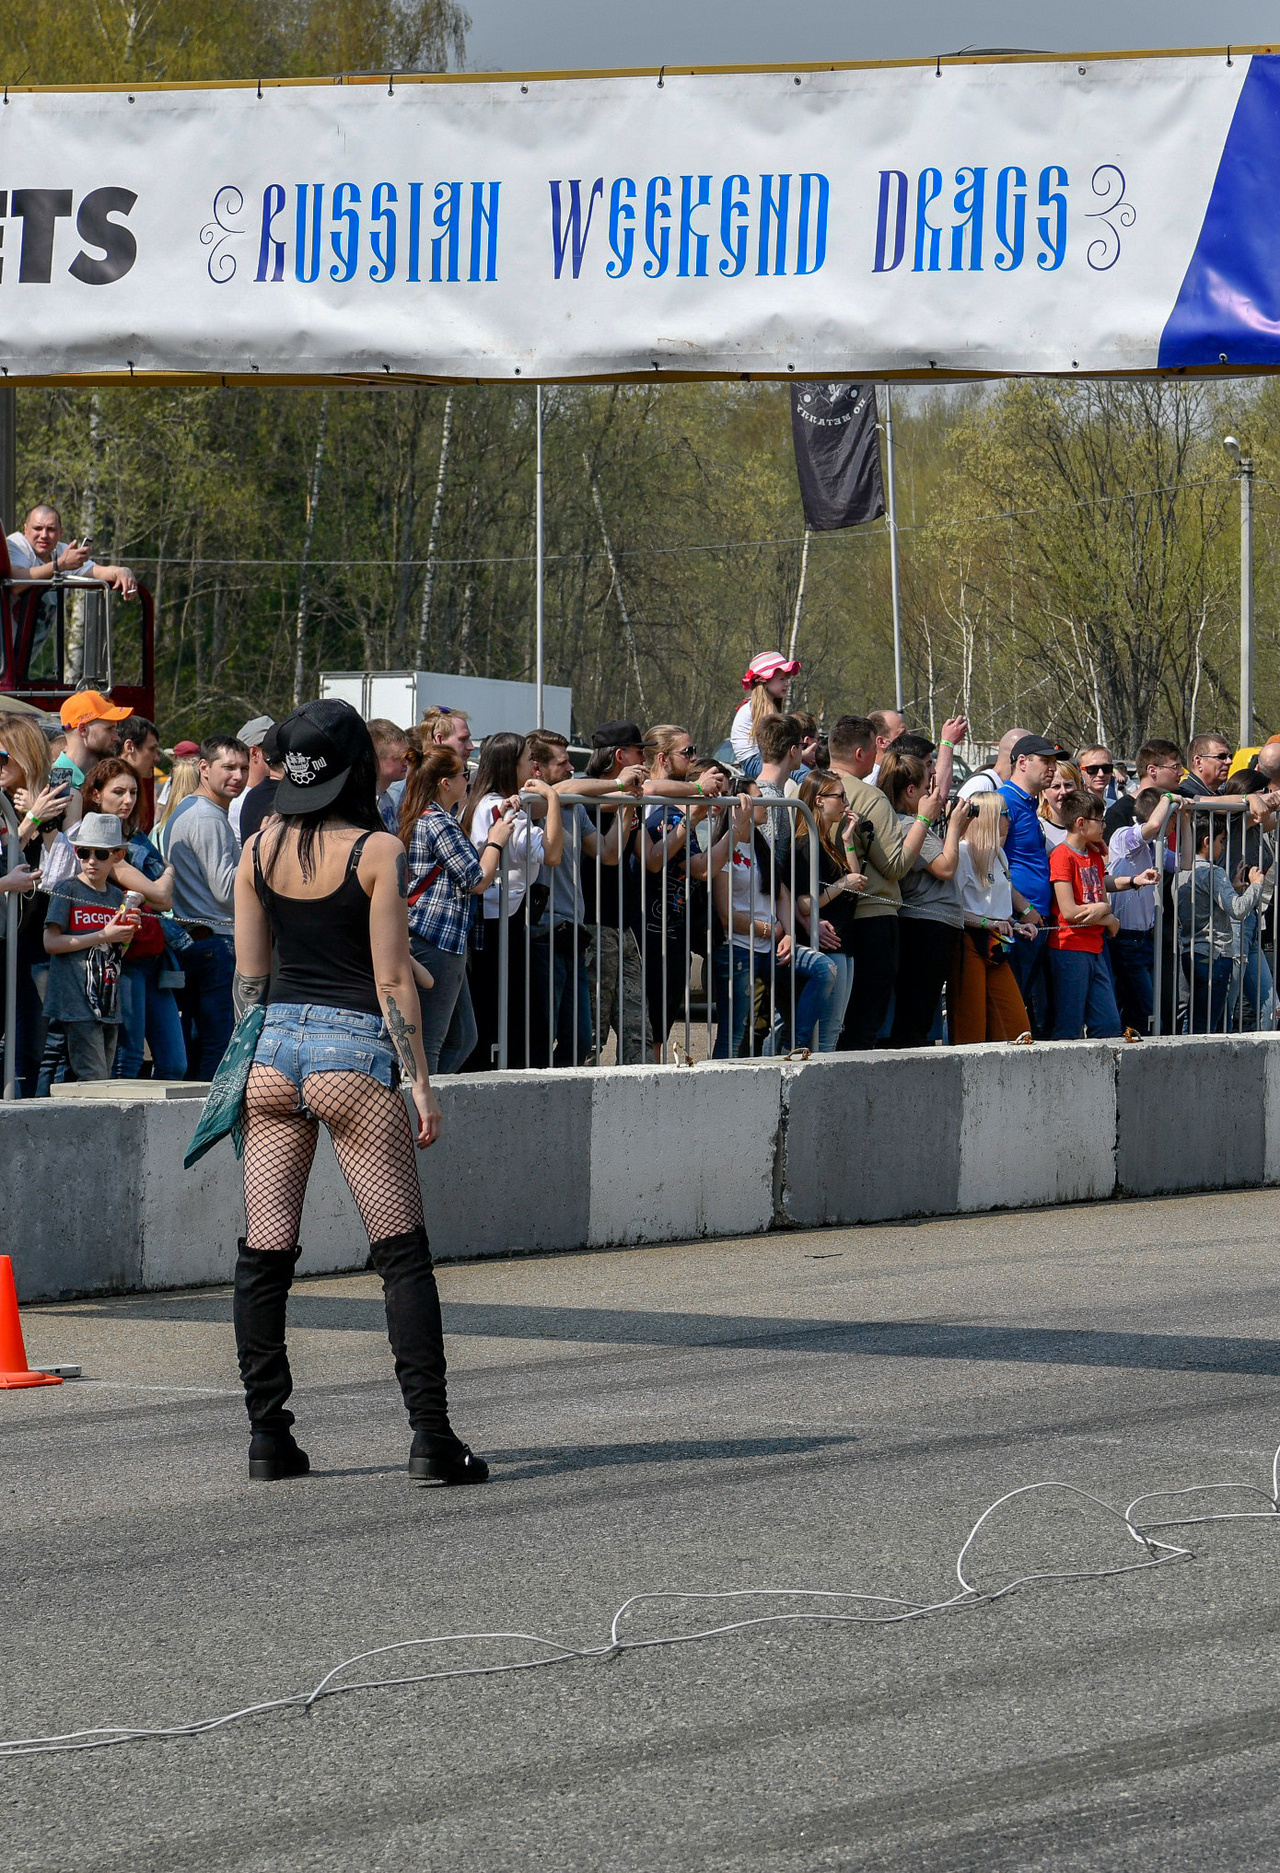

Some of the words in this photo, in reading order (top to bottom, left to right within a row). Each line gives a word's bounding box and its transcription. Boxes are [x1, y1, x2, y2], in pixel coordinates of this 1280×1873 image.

[0, 186, 139, 286] TS
[252, 181, 503, 284] RUSSIAN
[549, 172, 830, 280] WEEKEND
[872, 165, 1070, 272] DRAGS
